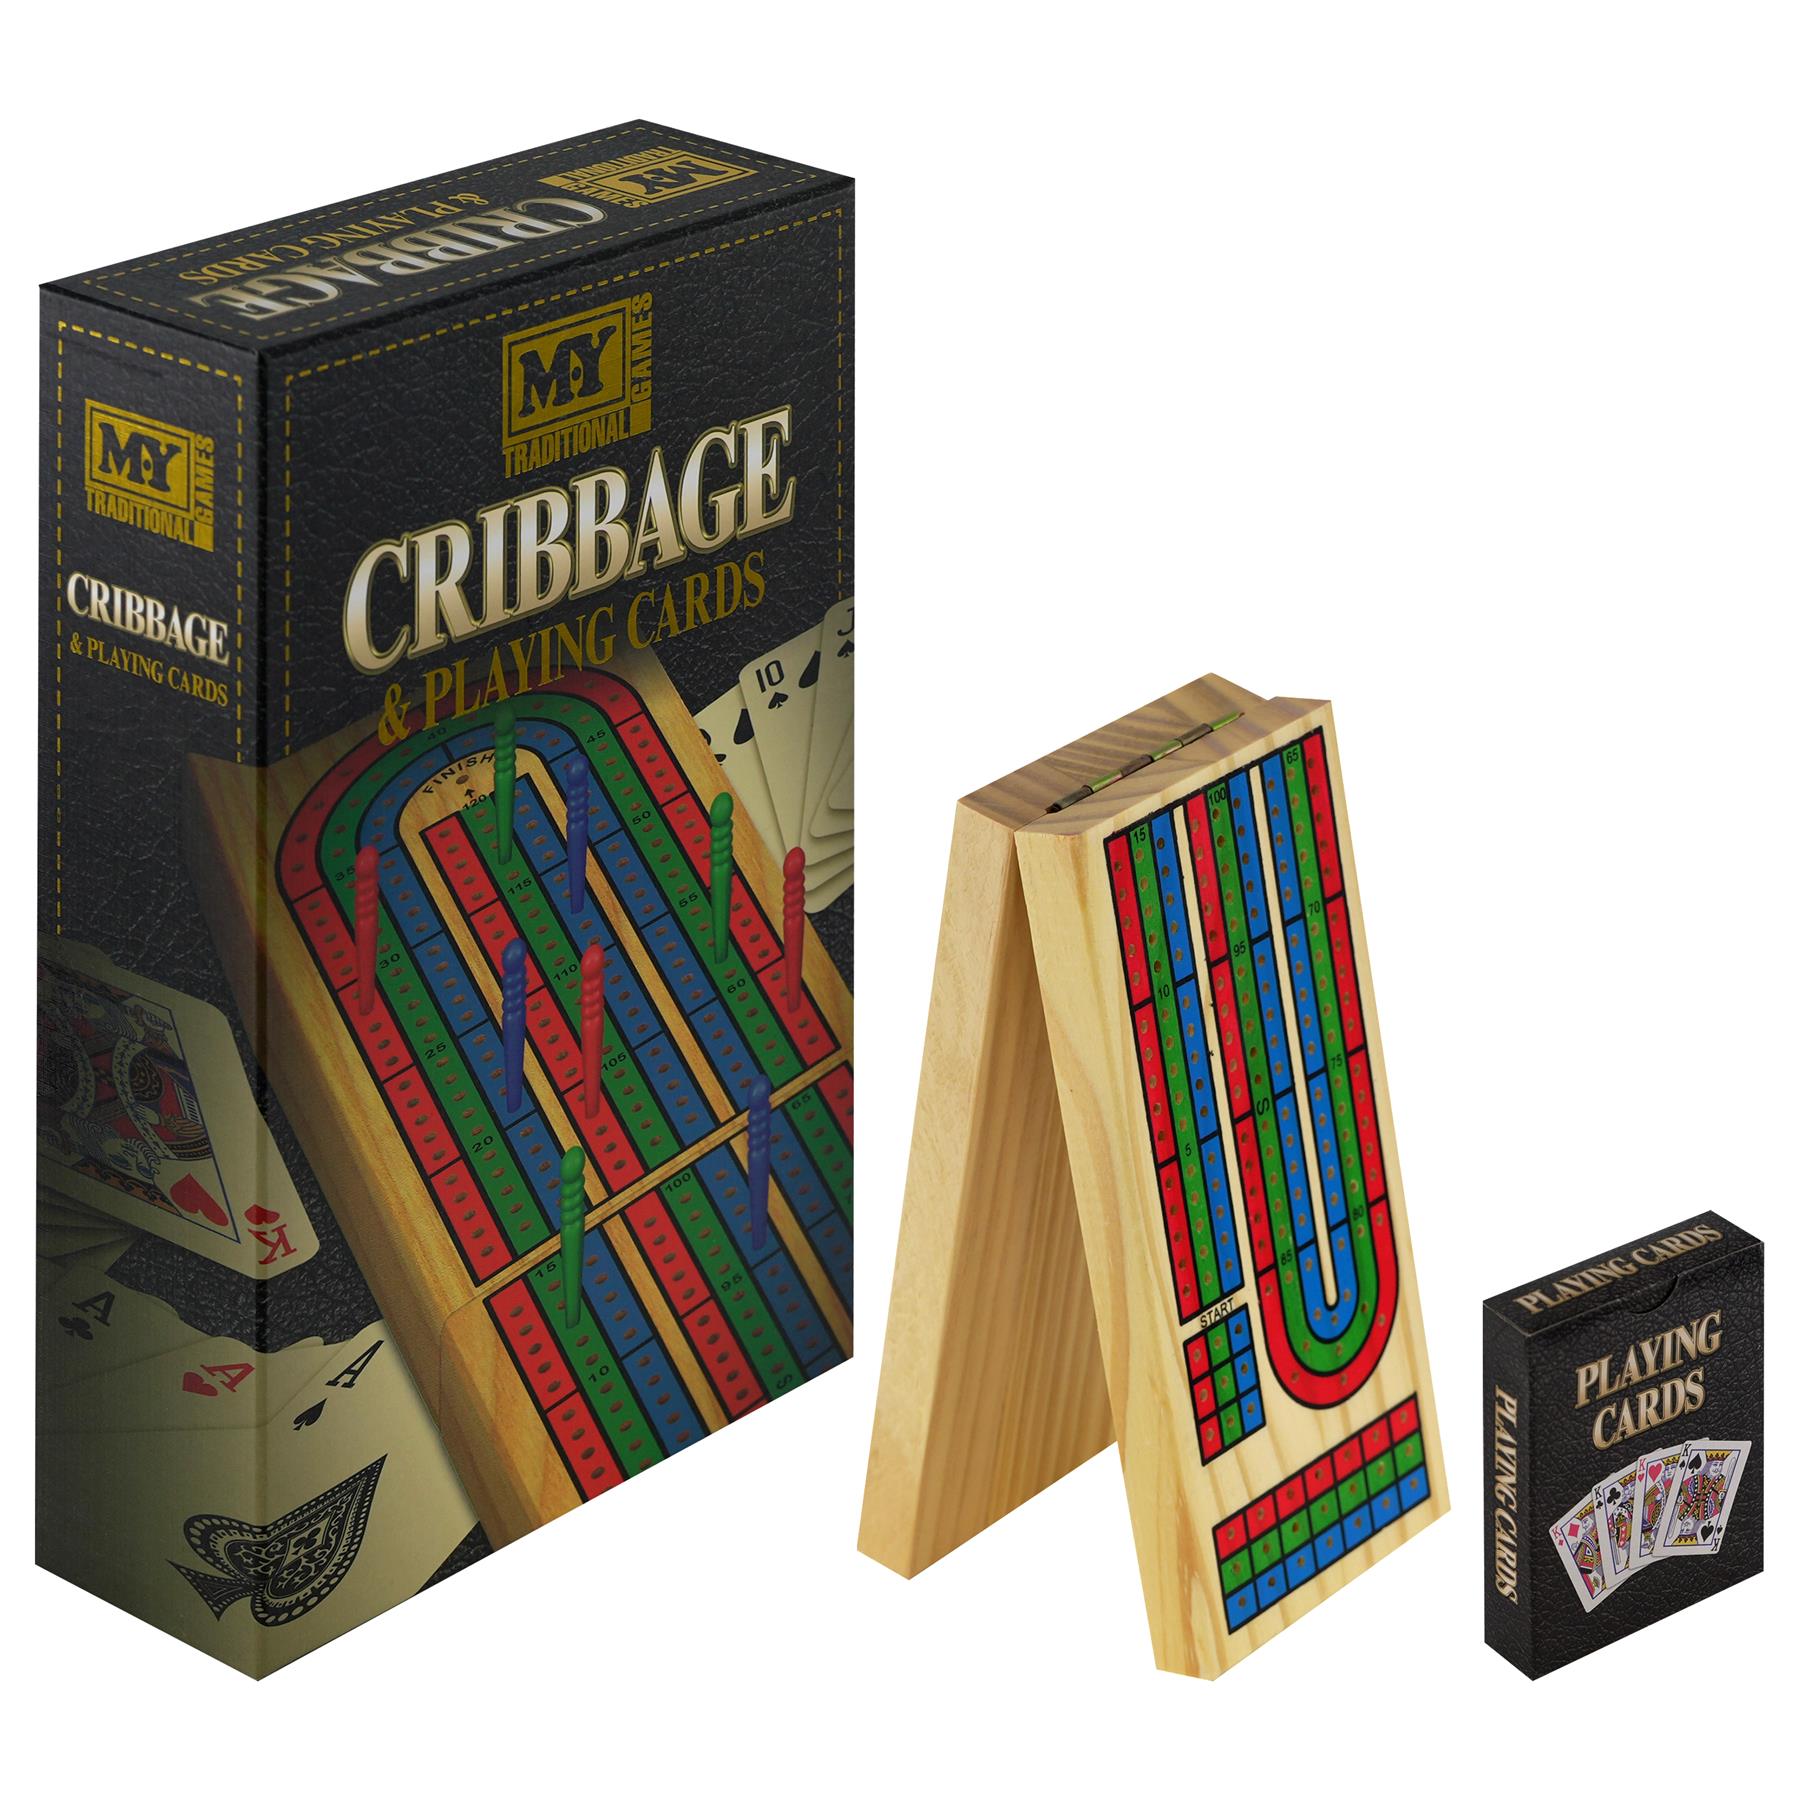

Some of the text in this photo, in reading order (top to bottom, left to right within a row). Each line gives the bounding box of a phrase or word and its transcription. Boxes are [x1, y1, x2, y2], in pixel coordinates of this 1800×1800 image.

[558, 146, 679, 181] TRADITIONAL
[560, 183, 650, 209] GAMES
[179, 193, 489, 285] & PLAYING CARDS
[190, 198, 608, 321] CRIBBAGE
[632, 292, 653, 401] GAMES
[503, 406, 631, 478] TRADITIONAL
[195, 434, 215, 525] GAMES
[86, 487, 195, 545] TRADITIONAL
[343, 405, 797, 677] CRIBBAGE
[66, 571, 231, 667] CRIBBAGE
[377, 551, 766, 746] & PLAYING CARDS
[70, 632, 229, 708] & PLAYING CARDS
[755, 660, 785, 693] 10
[586, 729, 607, 744] 45
[1286, 750, 1299, 764] 65
[422, 752, 495, 795] FINISH
[462, 794, 487, 811] 120
[1209, 787, 1227, 805] 100
[631, 810, 651, 825] 50
[1133, 828, 1147, 845] 15
[507, 877, 533, 896] 115
[679, 892, 698, 908] 55
[1308, 901, 1321, 916] 70
[1233, 942, 1246, 958] 95
[379, 953, 401, 969] 30
[553, 963, 579, 982] 110
[726, 978, 746, 994] 60
[1157, 984, 1170, 1000] 10
[424, 1042, 447, 1059] 25
[601, 1052, 627, 1071] 105
[1330, 1054, 1343, 1069] 75
[472, 1135, 494, 1153] 20
[1185, 1143, 1192, 1157] 5
[665, 1172, 692, 1193] 100
[247, 1223, 298, 1266] K
[535, 1260, 557, 1279] 15
[1512, 1224, 1724, 1314] PLAYING CARDS
[720, 1273, 743, 1292] 95
[72, 1290, 117, 1327] A
[1200, 1299, 1235, 1328] START
[325, 1340, 385, 1389] A
[1574, 1310, 1723, 1410] PLAYING
[200, 1361, 256, 1393] A
[588, 1365, 610, 1384] 10
[1592, 1366, 1706, 1450] CARDS
[1681, 1443, 1692, 1457] K
[1639, 1458, 1646, 1472] K
[1494, 1385, 1518, 1605] PLAYING CARDS
